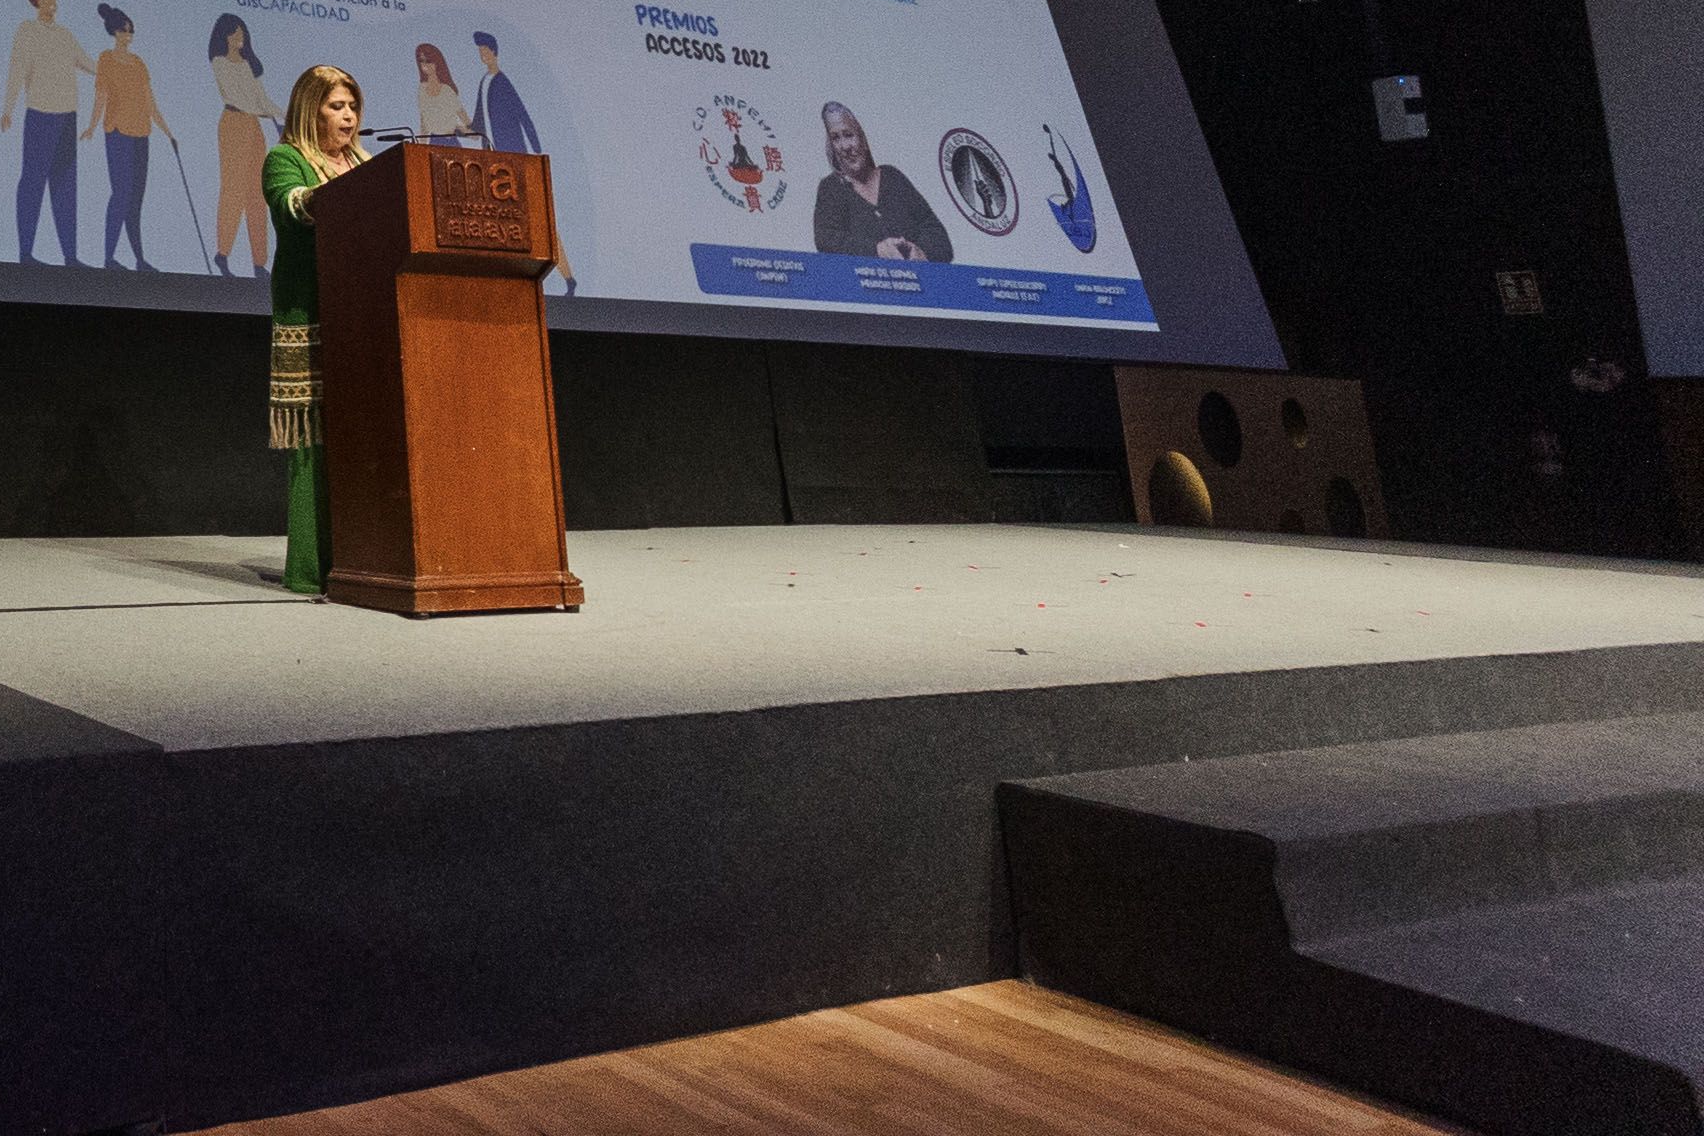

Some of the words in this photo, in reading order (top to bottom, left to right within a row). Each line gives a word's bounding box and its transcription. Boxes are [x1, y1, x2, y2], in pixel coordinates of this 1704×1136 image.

[381, 0, 390, 9] a
[634, 4, 719, 37] PREMIOS
[645, 33, 726, 64] ACCESOS
[732, 46, 771, 69] 2022
